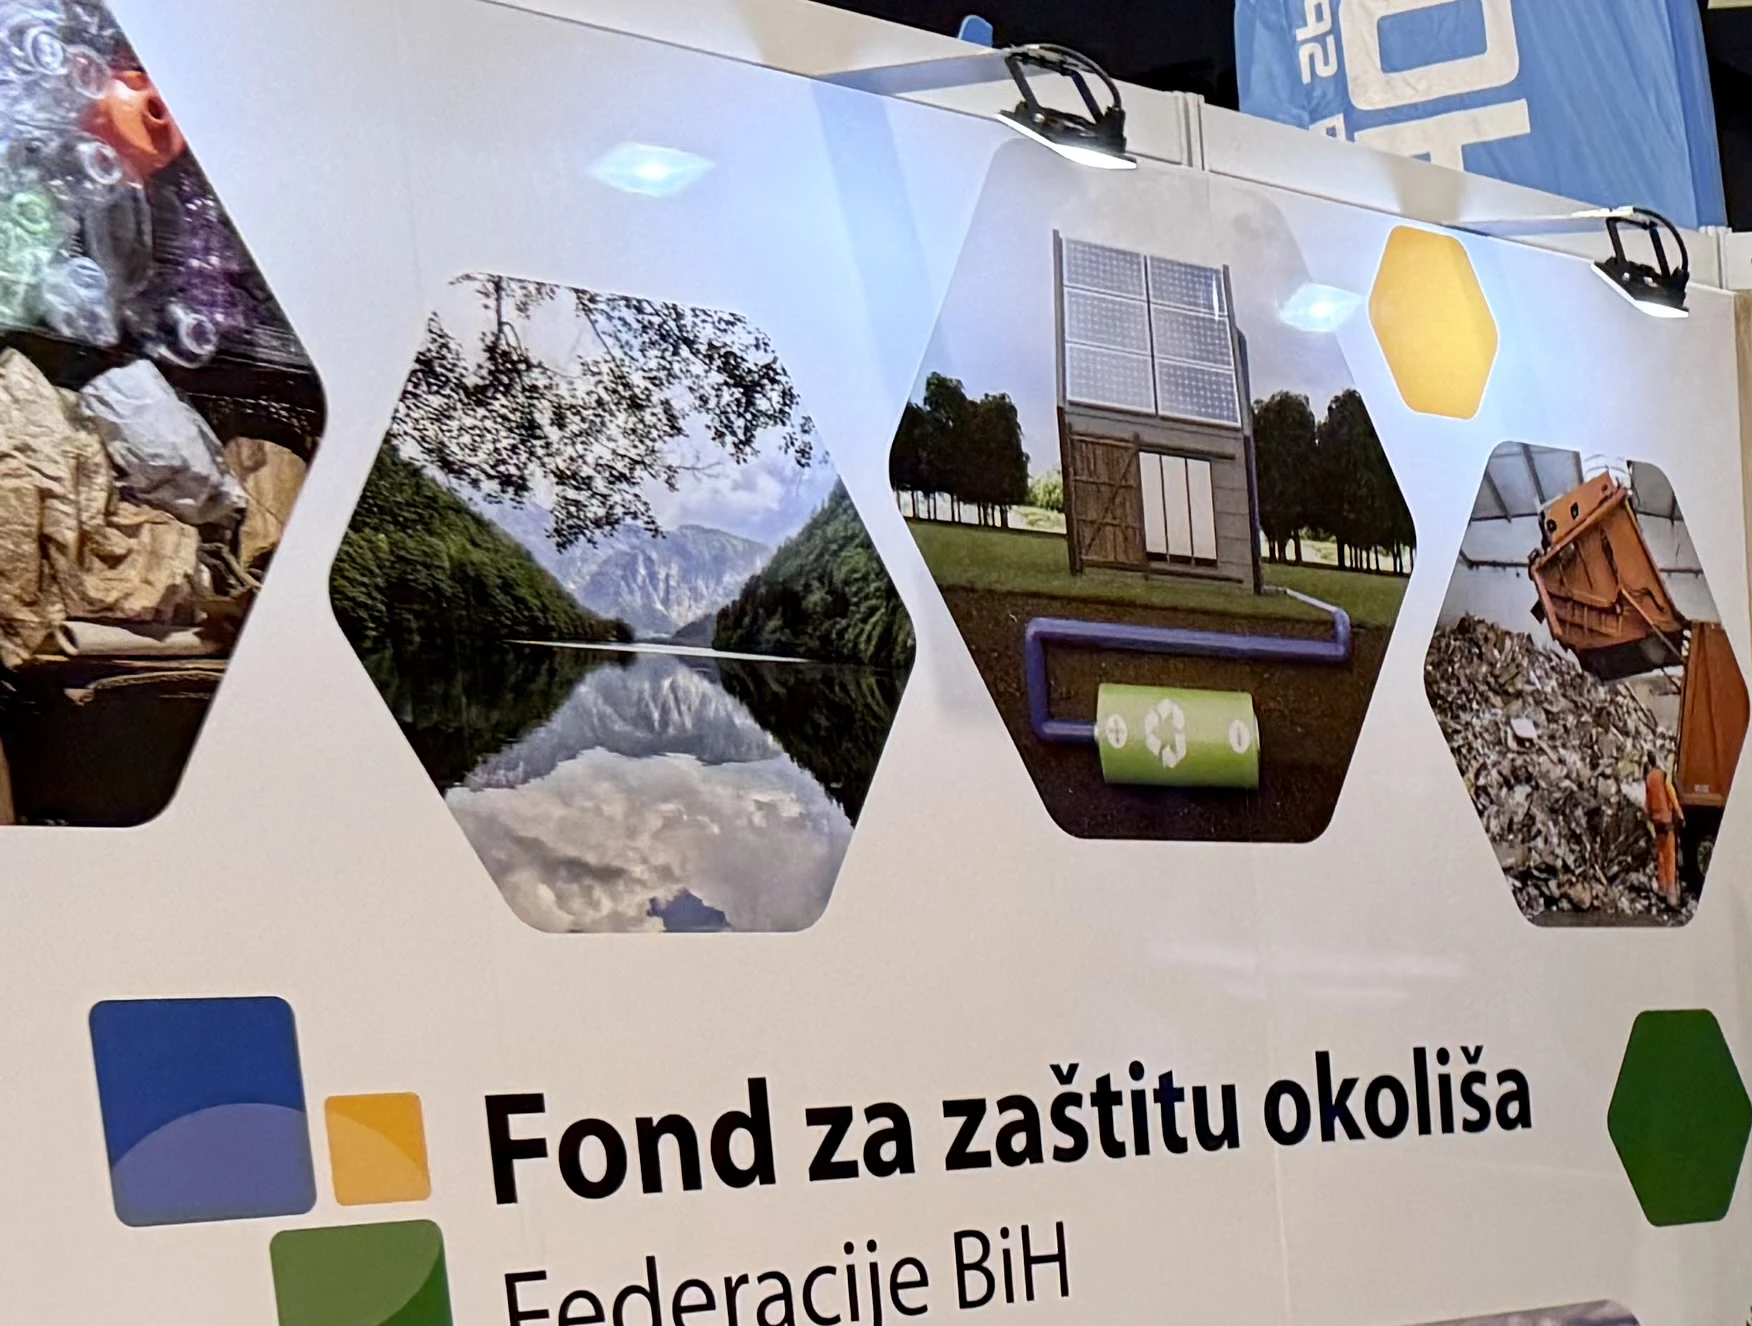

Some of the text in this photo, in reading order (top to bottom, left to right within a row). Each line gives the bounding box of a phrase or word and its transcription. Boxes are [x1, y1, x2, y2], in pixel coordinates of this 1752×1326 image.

[484, 1045, 1532, 1205] Fond za zaštitu okoliša
[953, 1220, 1069, 1310] BiH
